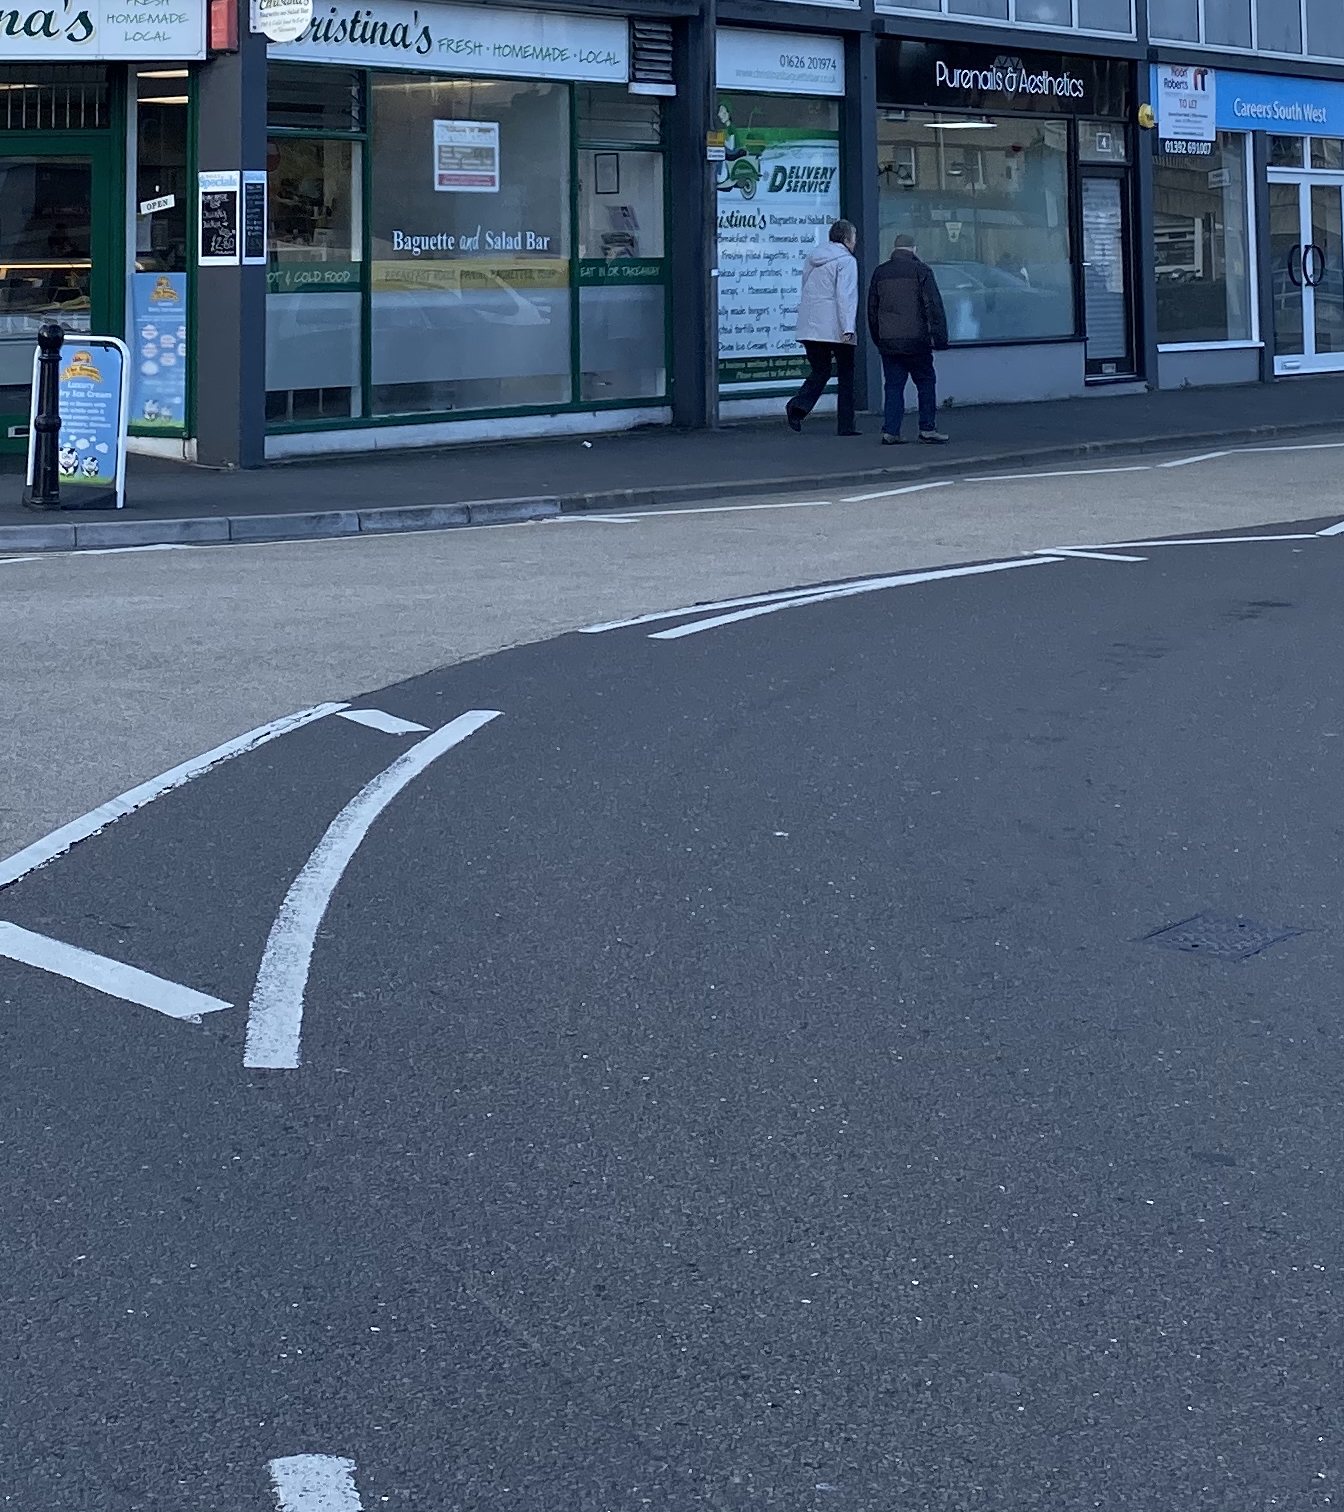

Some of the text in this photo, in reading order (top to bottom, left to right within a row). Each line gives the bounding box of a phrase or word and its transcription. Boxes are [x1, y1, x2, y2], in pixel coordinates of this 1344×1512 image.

[106, 12, 189, 24] HOMEMADE
[124, 31, 172, 42] LOCAL
[297, 7, 432, 54] ristina's
[438, 37, 483, 56] FRESH
[493, 43, 570, 62] HOMEMADE
[579, 49, 621, 65] LOCAL
[779, 54, 836, 70] 01626 201974
[936, 61, 1084, 98] Purenails & Aesthetics
[1164, 77, 1188, 90] Roberts
[1233, 97, 1272, 119] Careers
[1273, 100, 1302, 121] South
[1304, 103, 1327, 124] West
[1165, 140, 1186, 153] 01392
[768, 165, 837, 192] DELIVERY
[786, 180, 832, 193] SERVICE
[146, 198, 169, 210] OPEN
[718, 208, 766, 230] istina's
[392, 225, 550, 256] Baguette and Salad Bar
[267, 272, 283, 283] OT
[294, 271, 322, 283] COLD
[324, 271, 351, 283] FOOD
[580, 265, 596, 277] EAT
[87, 390, 112, 399] Cream
